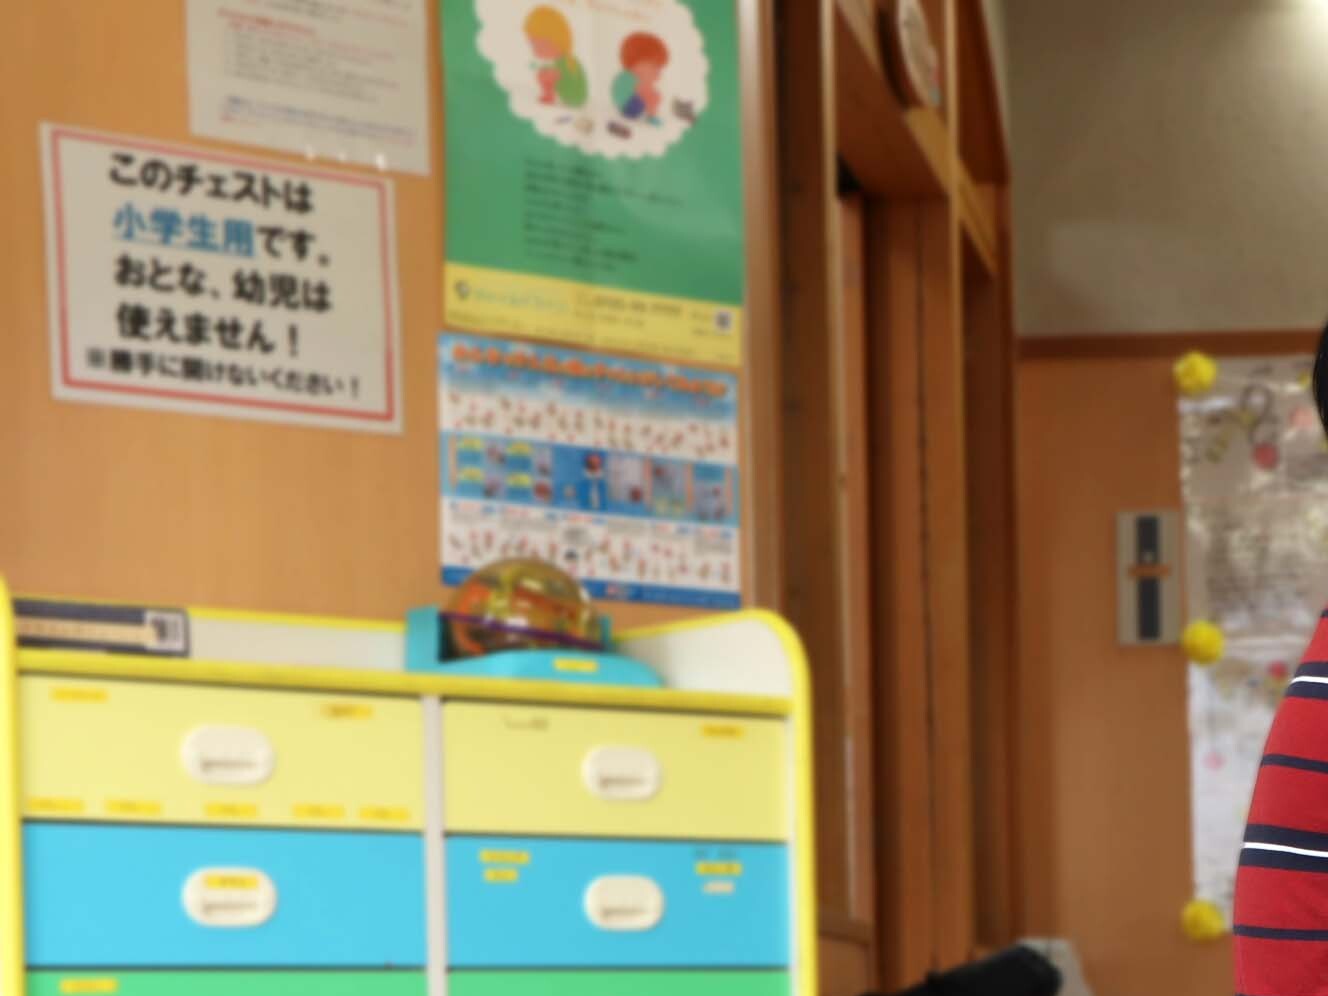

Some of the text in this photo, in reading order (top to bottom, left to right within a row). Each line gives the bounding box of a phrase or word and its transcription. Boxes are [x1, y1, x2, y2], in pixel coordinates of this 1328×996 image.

[109, 152, 314, 214] このチェストは
[113, 202, 331, 266] 小学生用です。
